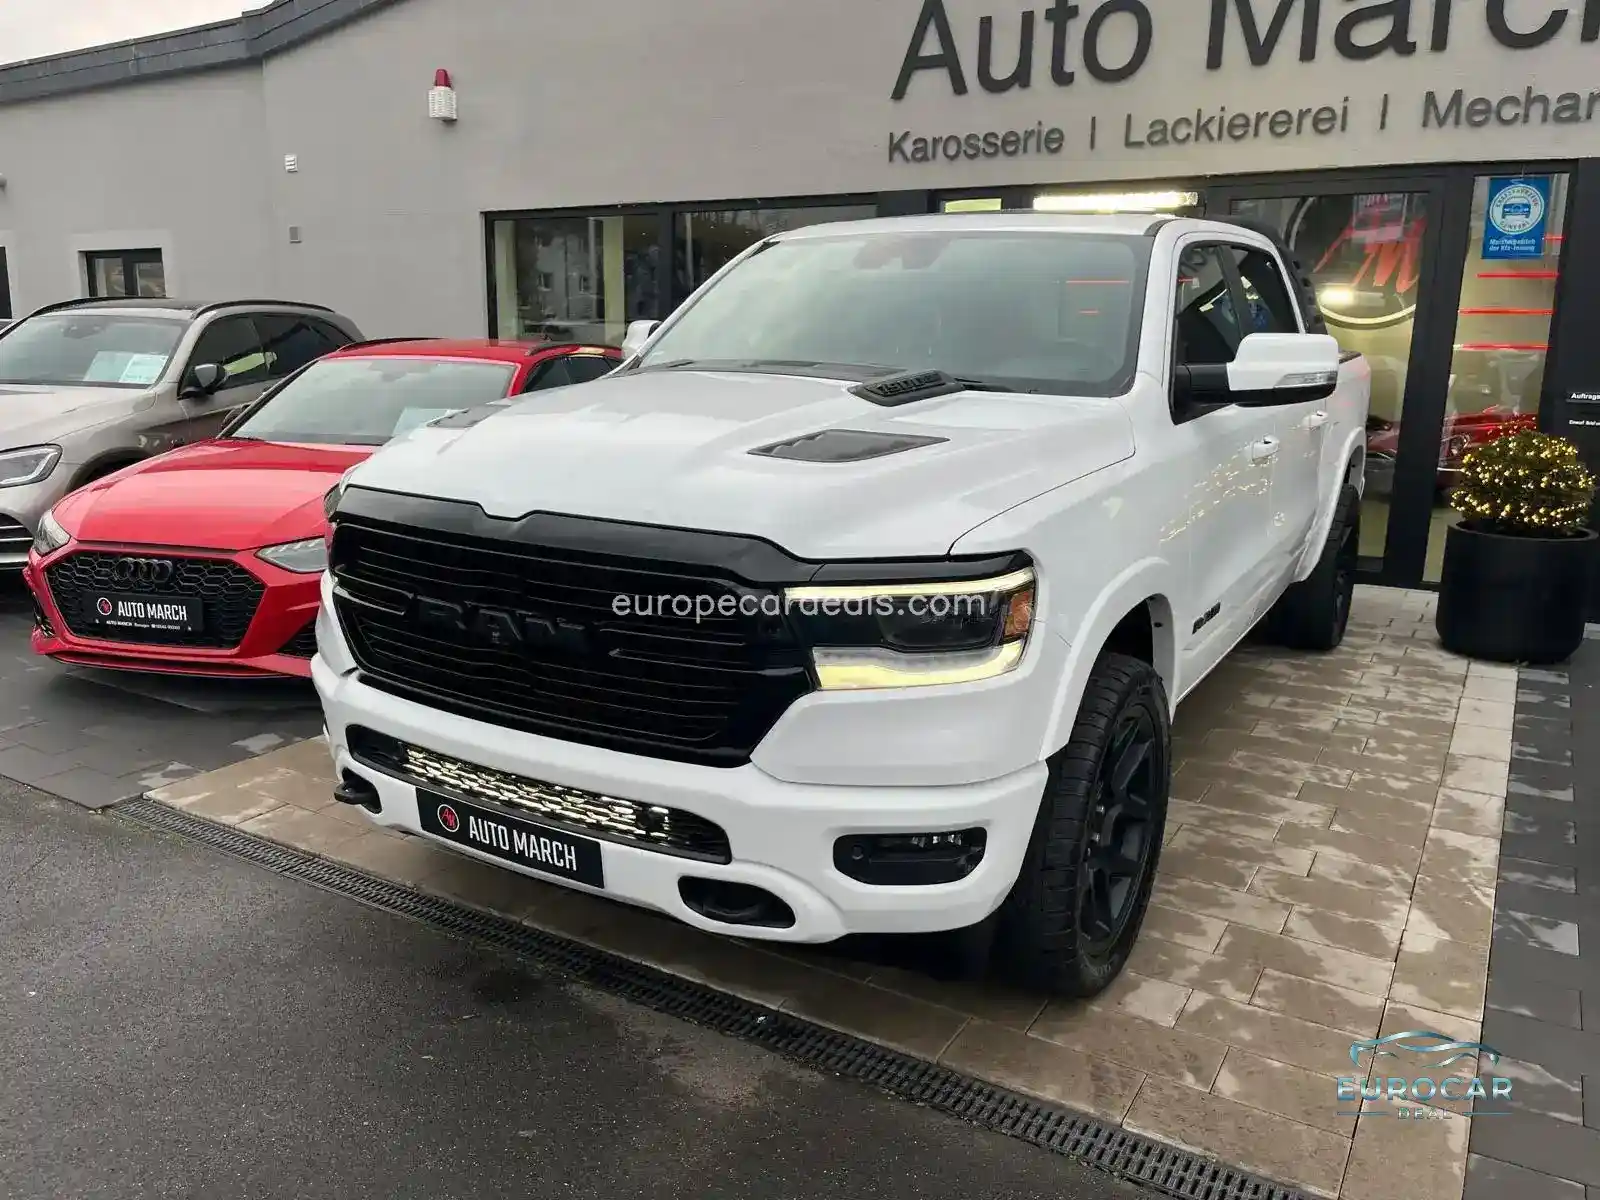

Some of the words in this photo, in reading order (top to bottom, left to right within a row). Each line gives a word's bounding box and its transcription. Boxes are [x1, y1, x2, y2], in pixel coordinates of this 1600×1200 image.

[890, 0, 1152, 100] Auto
[1206, 0, 1600, 70] Marc
[888, 121, 1065, 163] Karosserie
[1124, 96, 1349, 148] Lackiererei
[118, 601, 145, 618] AUTO
[147, 603, 187, 621] MARCH
[469, 816, 509, 850] AUTO
[513, 829, 577, 871] MARCH
